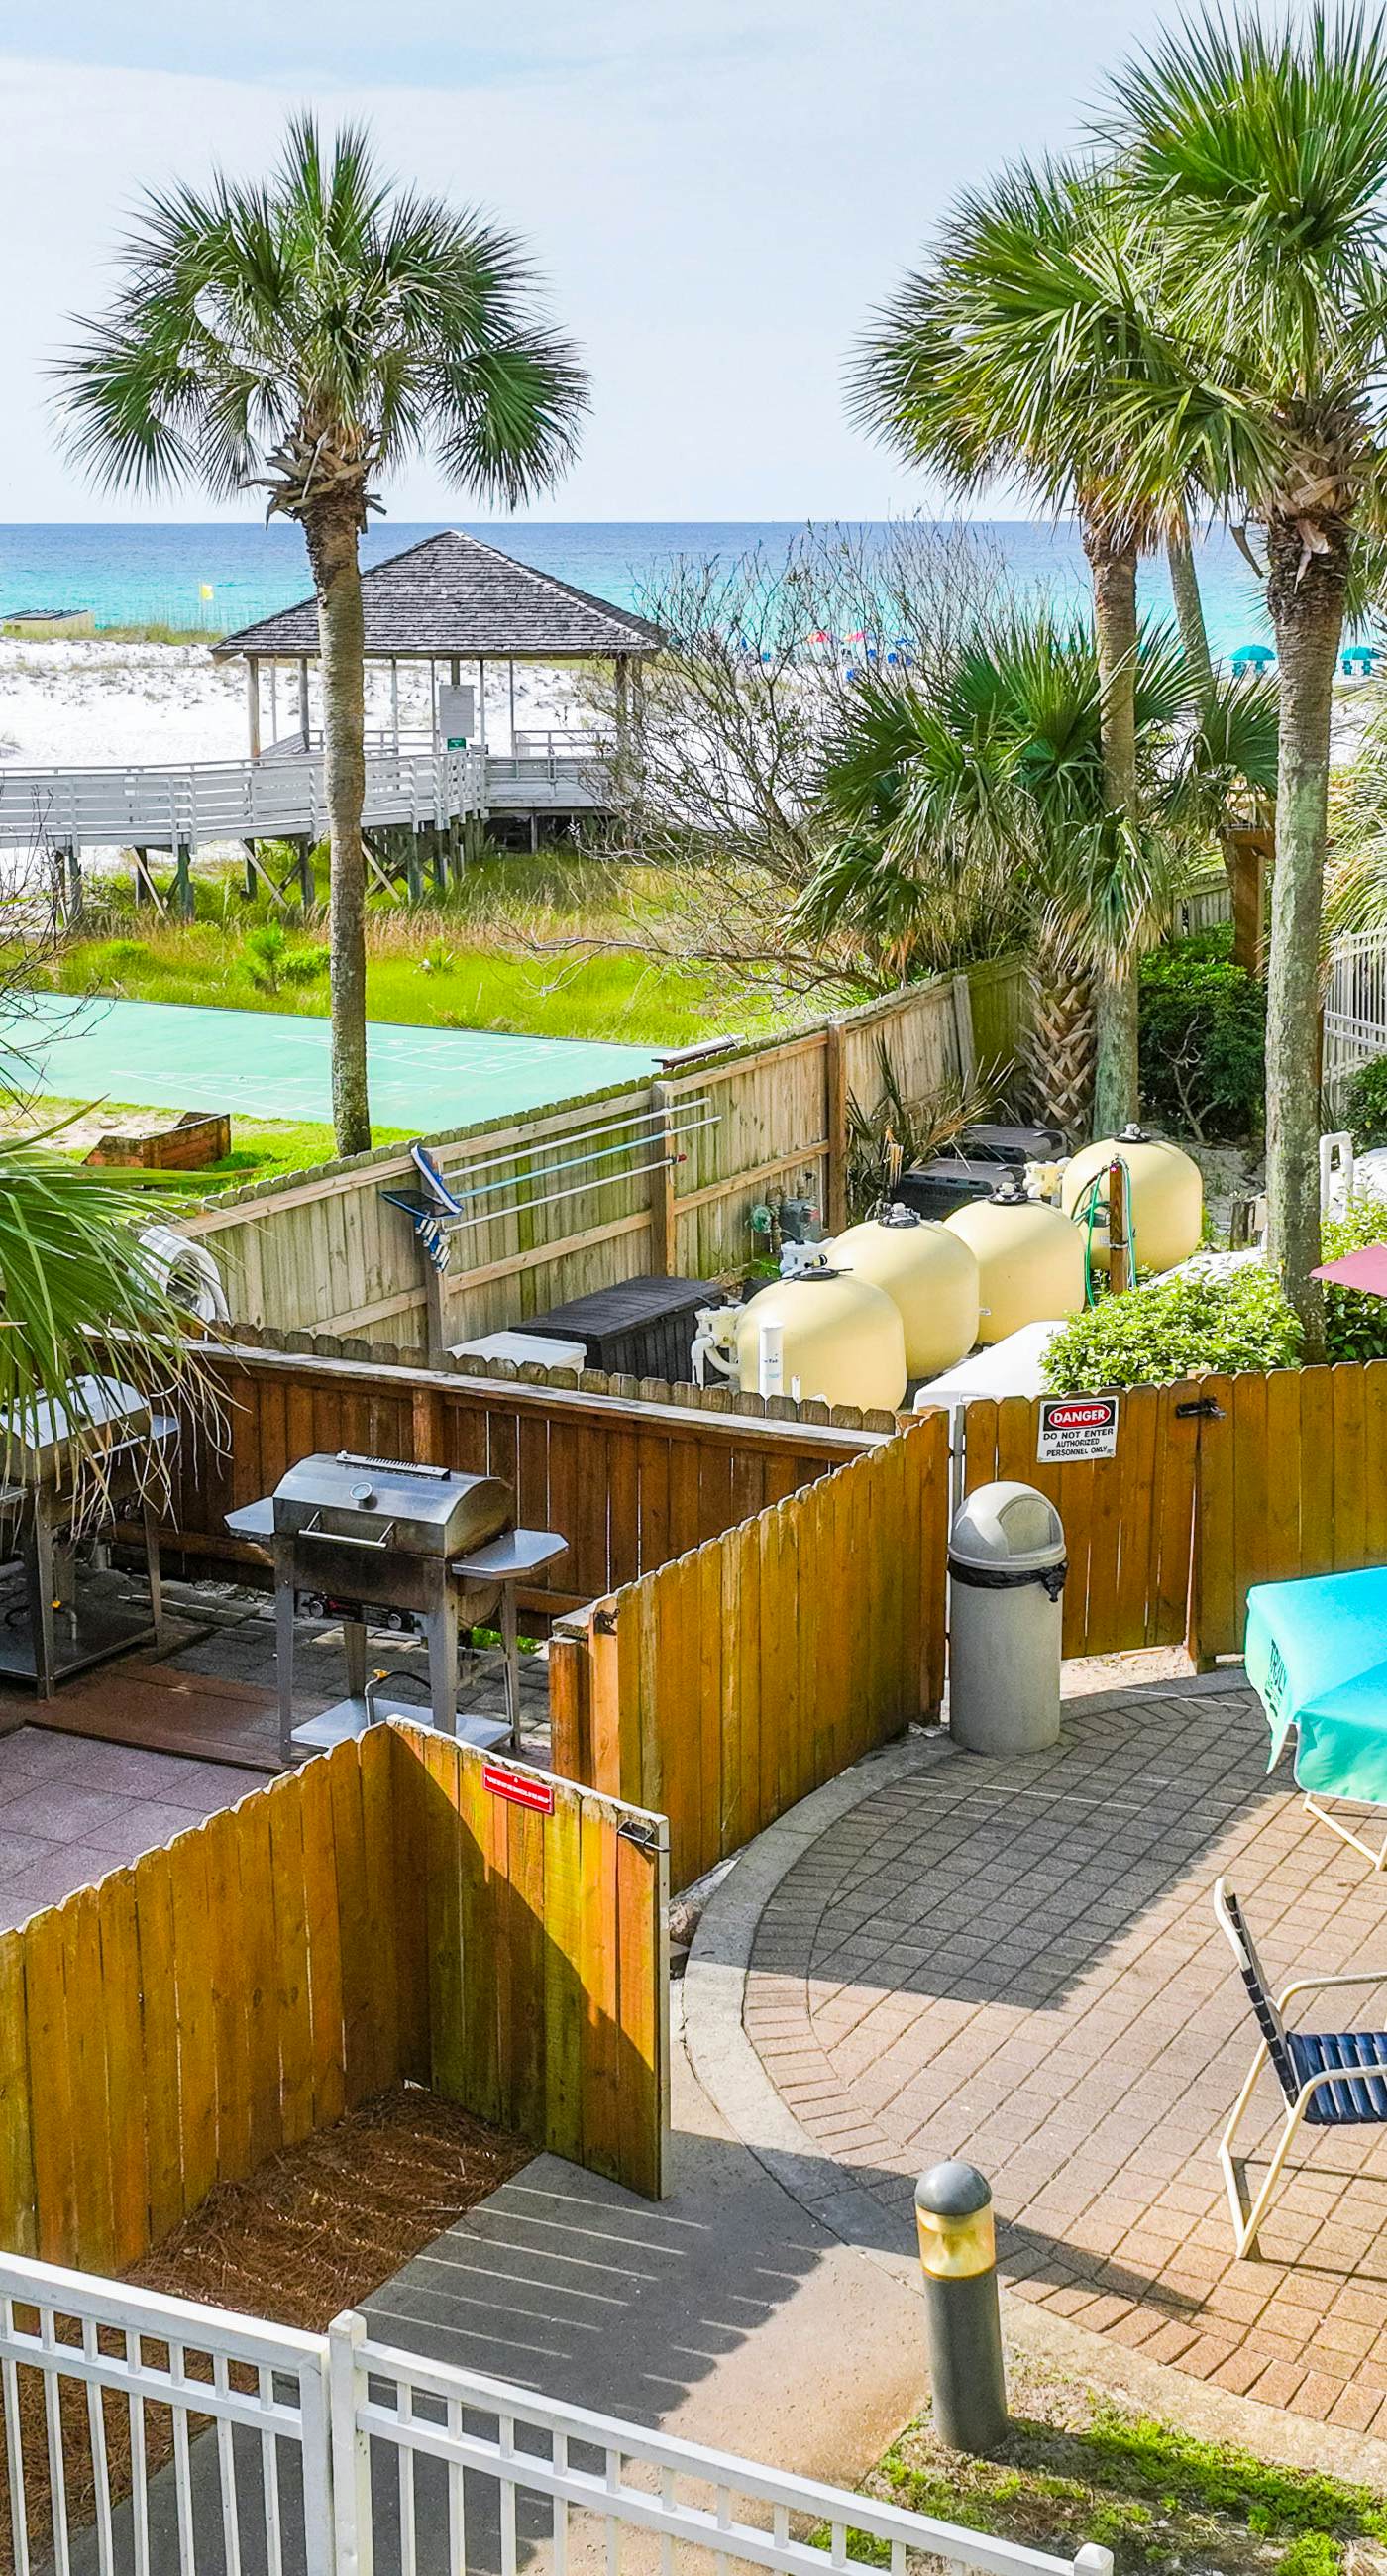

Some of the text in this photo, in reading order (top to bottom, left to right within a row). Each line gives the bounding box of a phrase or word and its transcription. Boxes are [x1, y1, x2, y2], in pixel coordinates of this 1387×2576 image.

[1053, 1409, 1105, 1423] DANGER
[1084, 1428, 1114, 1437] ENTER
[1056, 1438, 1100, 1448] AUTHORIZED
[1046, 1448, 1088, 1456] PERSONNEL
